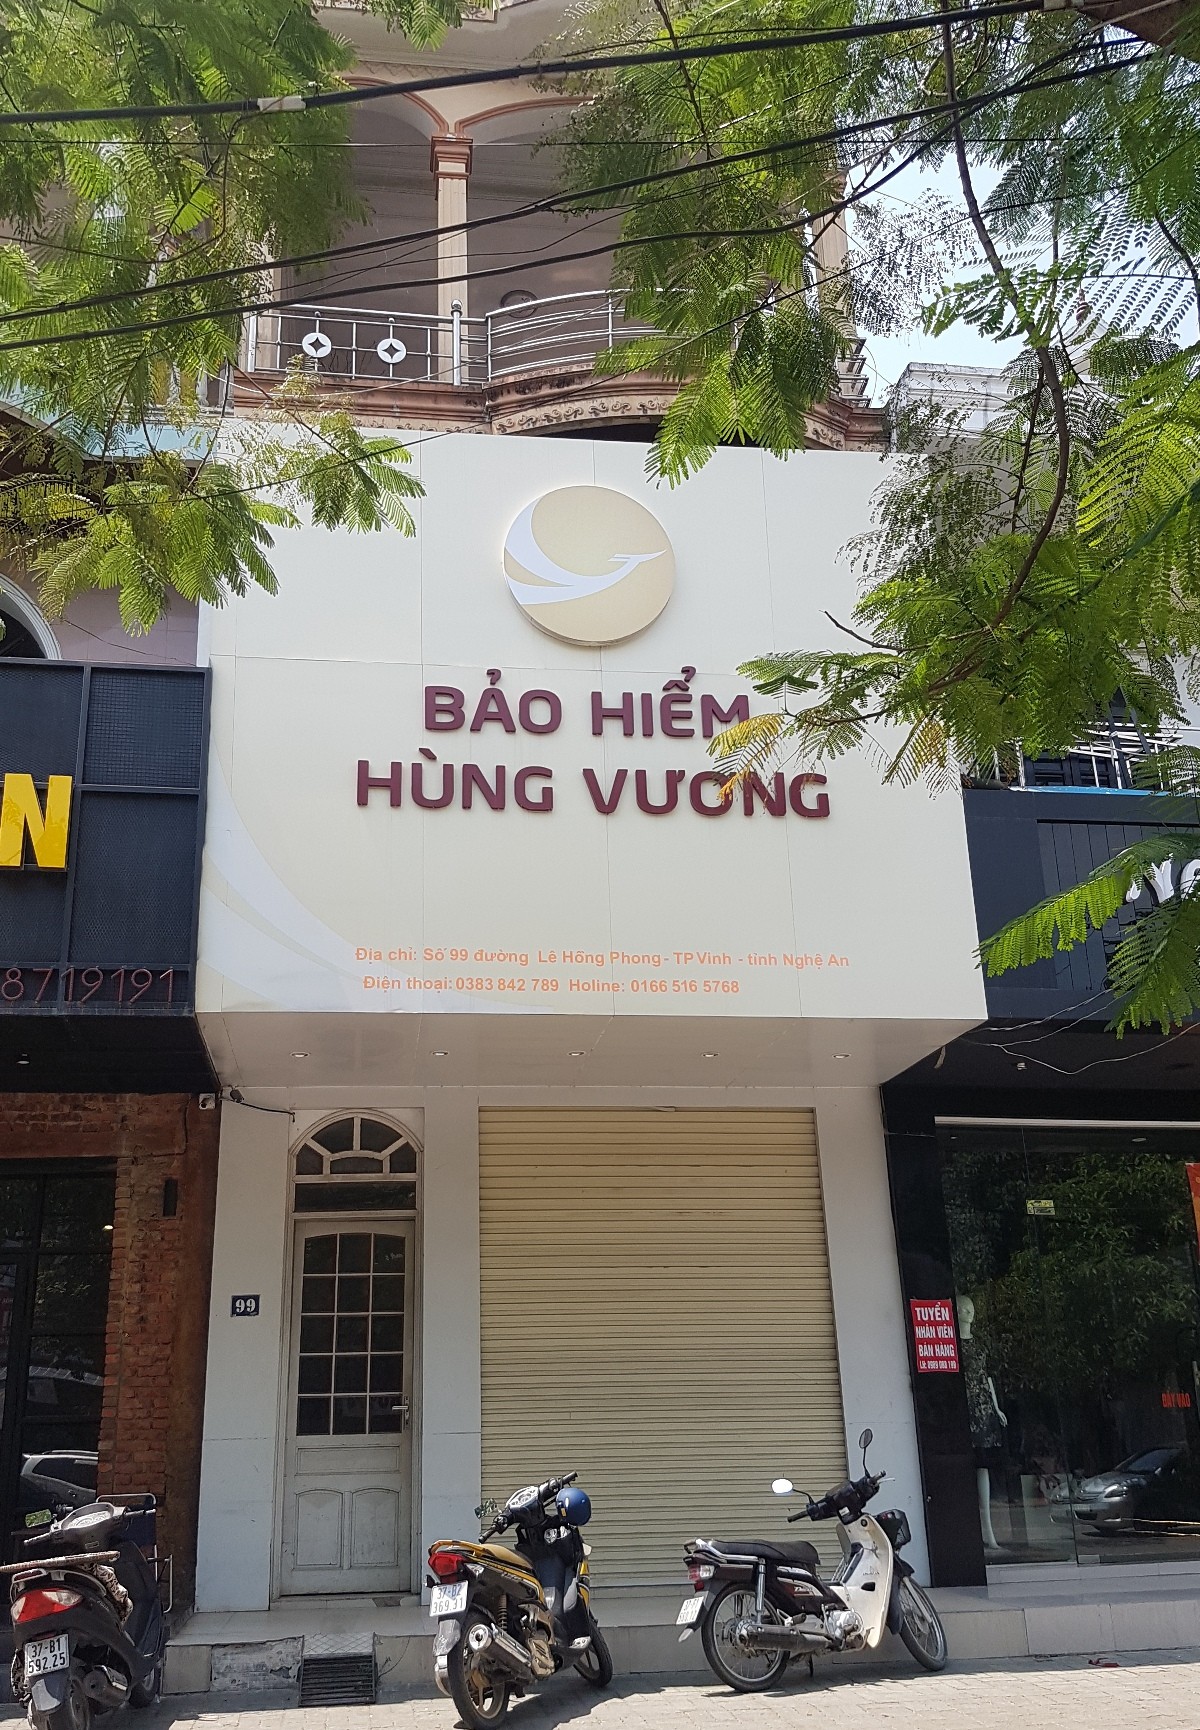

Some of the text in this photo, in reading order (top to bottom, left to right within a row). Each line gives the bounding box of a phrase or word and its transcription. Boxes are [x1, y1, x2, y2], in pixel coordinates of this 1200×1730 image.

[424, 666, 751, 738] BẢO HIỂM
[357, 748, 830, 818] HÙNG VƯƠNG
[355, 948, 383, 965] Địa
[388, 947, 417, 961] chỉ:
[423, 948, 447, 961] Số
[449, 948, 470, 961] 99
[473, 949, 529, 967] đường
[538, 950, 557, 963] Lê
[562, 950, 606, 967] Hồng
[610, 951, 662, 967] Phong
[673, 952, 694, 965] TP
[696, 952, 731, 965] Vinh
[748, 952, 777, 966] tỉnh
[783, 953, 823, 970] Nghệ
[828, 954, 849, 967] An
[2, 965, 174, 1005] 8719191
[363, 976, 739, 994] Điện thoại: 0383 842 789 Holine: 0166 516 5768
[235, 1298, 256, 1313] 99
[915, 1302, 950, 1321] TUYỂN
[918, 1342, 934, 1357] BÁN
[432, 1597, 464, 1614] 369.31
[31, 1638, 61, 1658] 37-B1
[28, 1651, 66, 1674] 592.25
